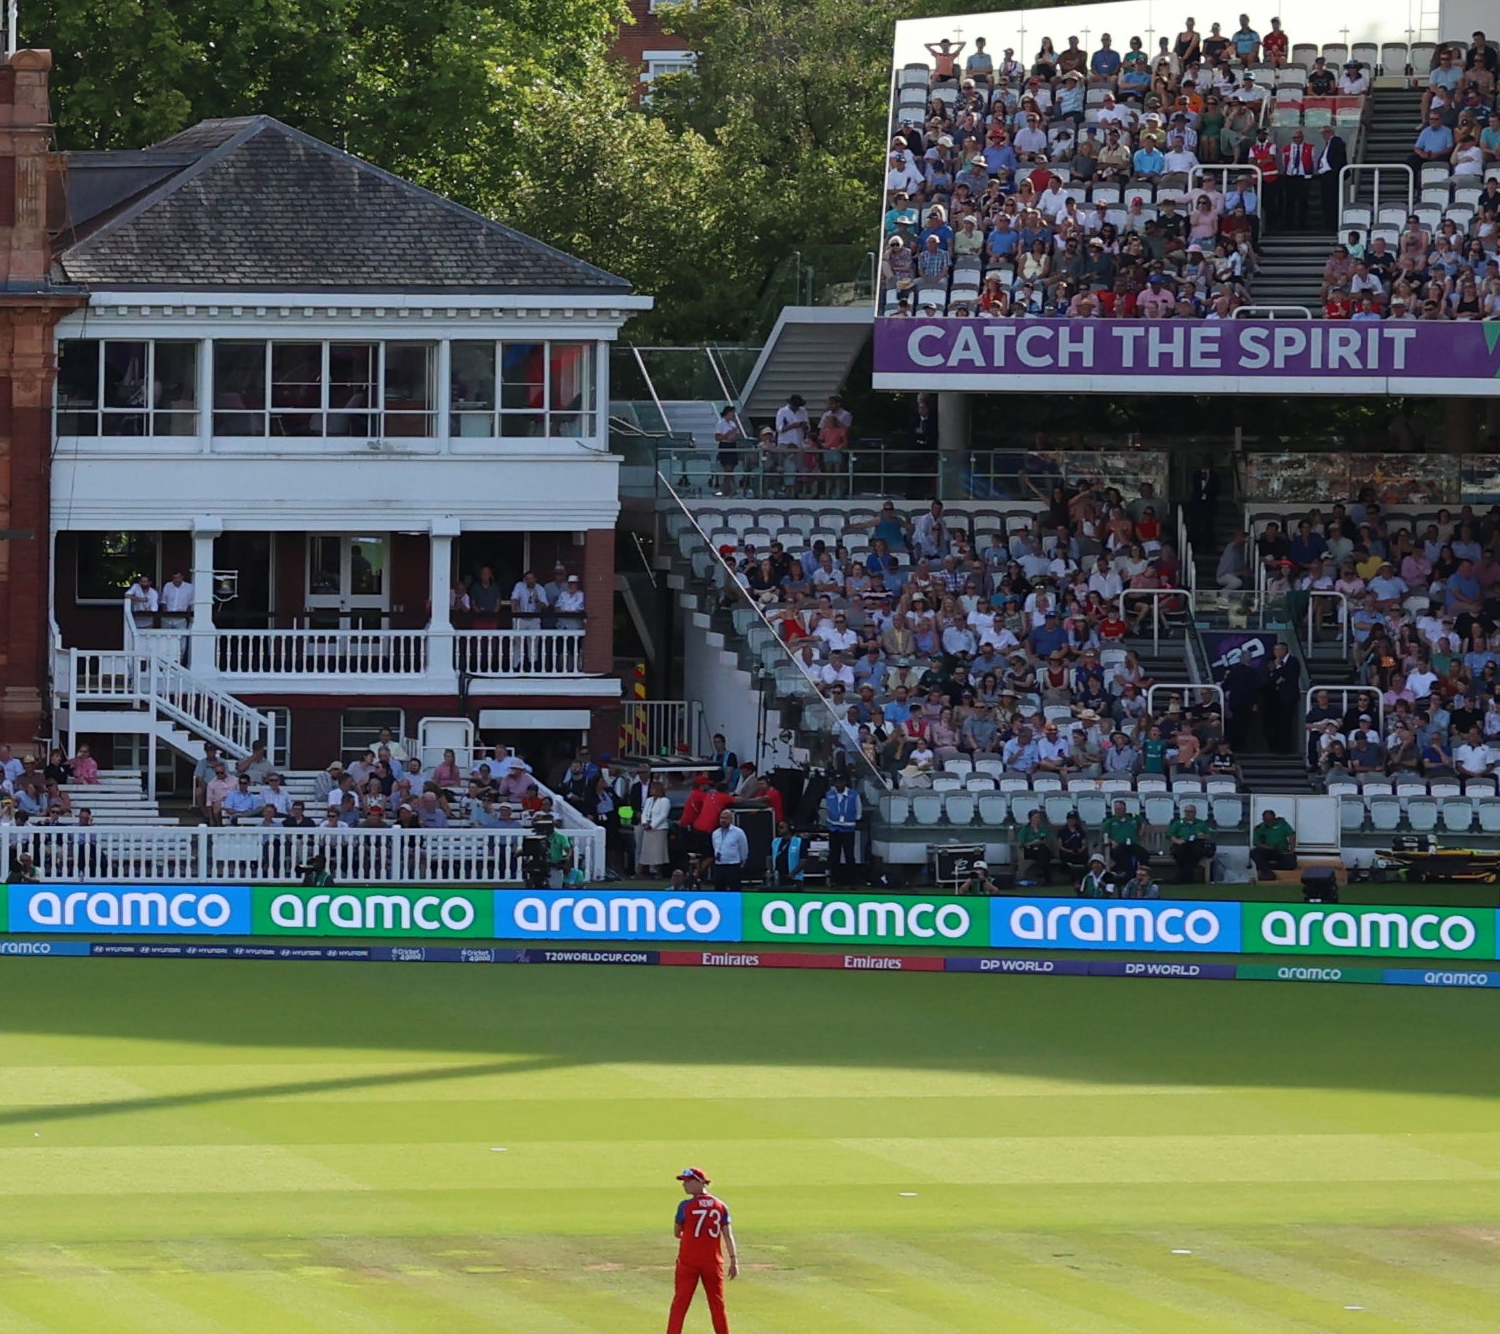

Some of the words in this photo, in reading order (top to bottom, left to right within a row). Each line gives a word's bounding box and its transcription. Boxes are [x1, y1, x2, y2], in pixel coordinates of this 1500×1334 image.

[908, 326, 1094, 369] CATCH
[1113, 327, 1221, 368] THE
[1238, 327, 1416, 369] SPIRIT
[28, 891, 231, 927] aramco
[270, 894, 475, 930] aramco
[513, 897, 721, 934] aramco
[761, 900, 970, 938] aramco
[1010, 905, 1220, 944] aramco
[1261, 910, 1476, 951] aramco
[545, 952, 647, 963] T20WORLDCUP.COM
[702, 952, 759, 966] Emirates
[844, 955, 902, 969] Emirates
[980, 959, 1001, 970] DP
[1002, 960, 1054, 972] WORLD
[1125, 963, 1146, 974] DP
[1147, 964, 1200, 976] WORLD
[1277, 967, 1342, 980] aramco
[1424, 972, 1488, 985] aramco
[691, 1209, 721, 1238] 73
